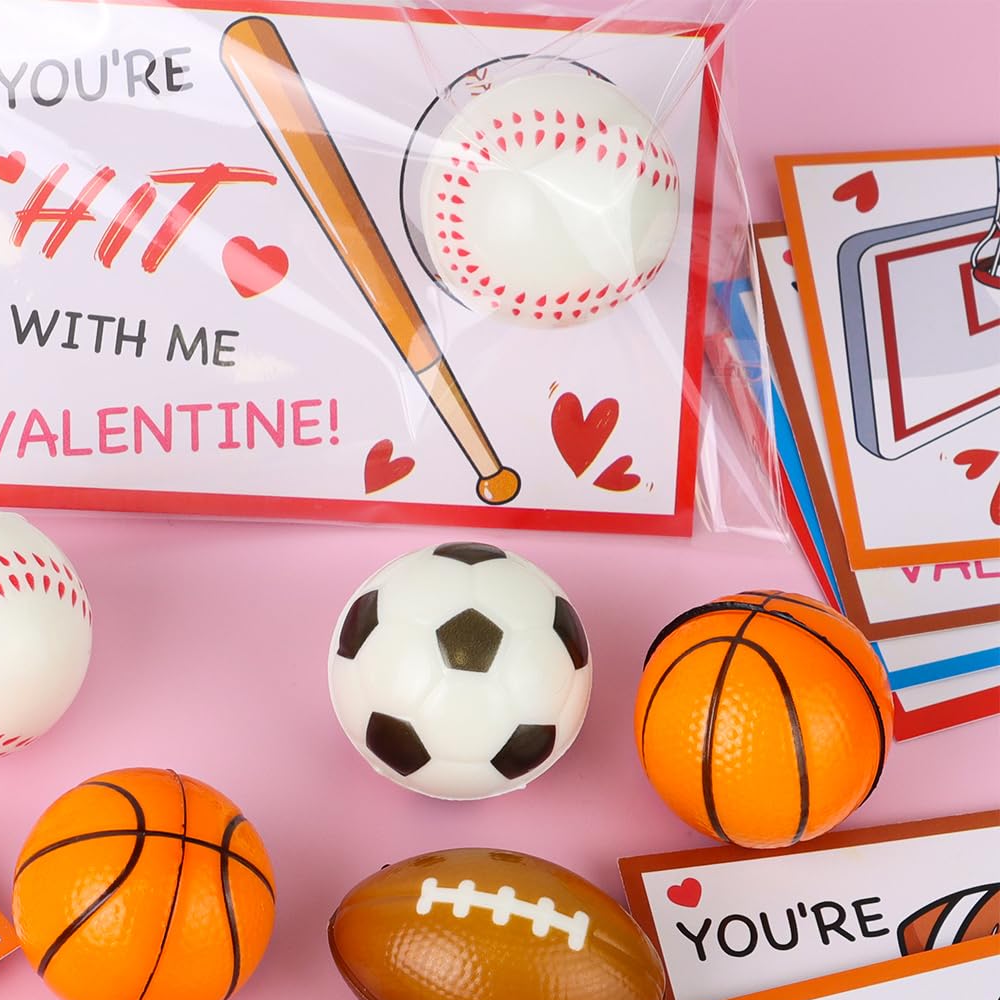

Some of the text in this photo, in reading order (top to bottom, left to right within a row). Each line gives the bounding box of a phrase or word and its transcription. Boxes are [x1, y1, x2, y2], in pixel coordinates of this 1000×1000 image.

[8, 162, 278, 273] HIT
[10, 304, 240, 367] WITH ME
[676, 896, 890, 962] YOU'RE
